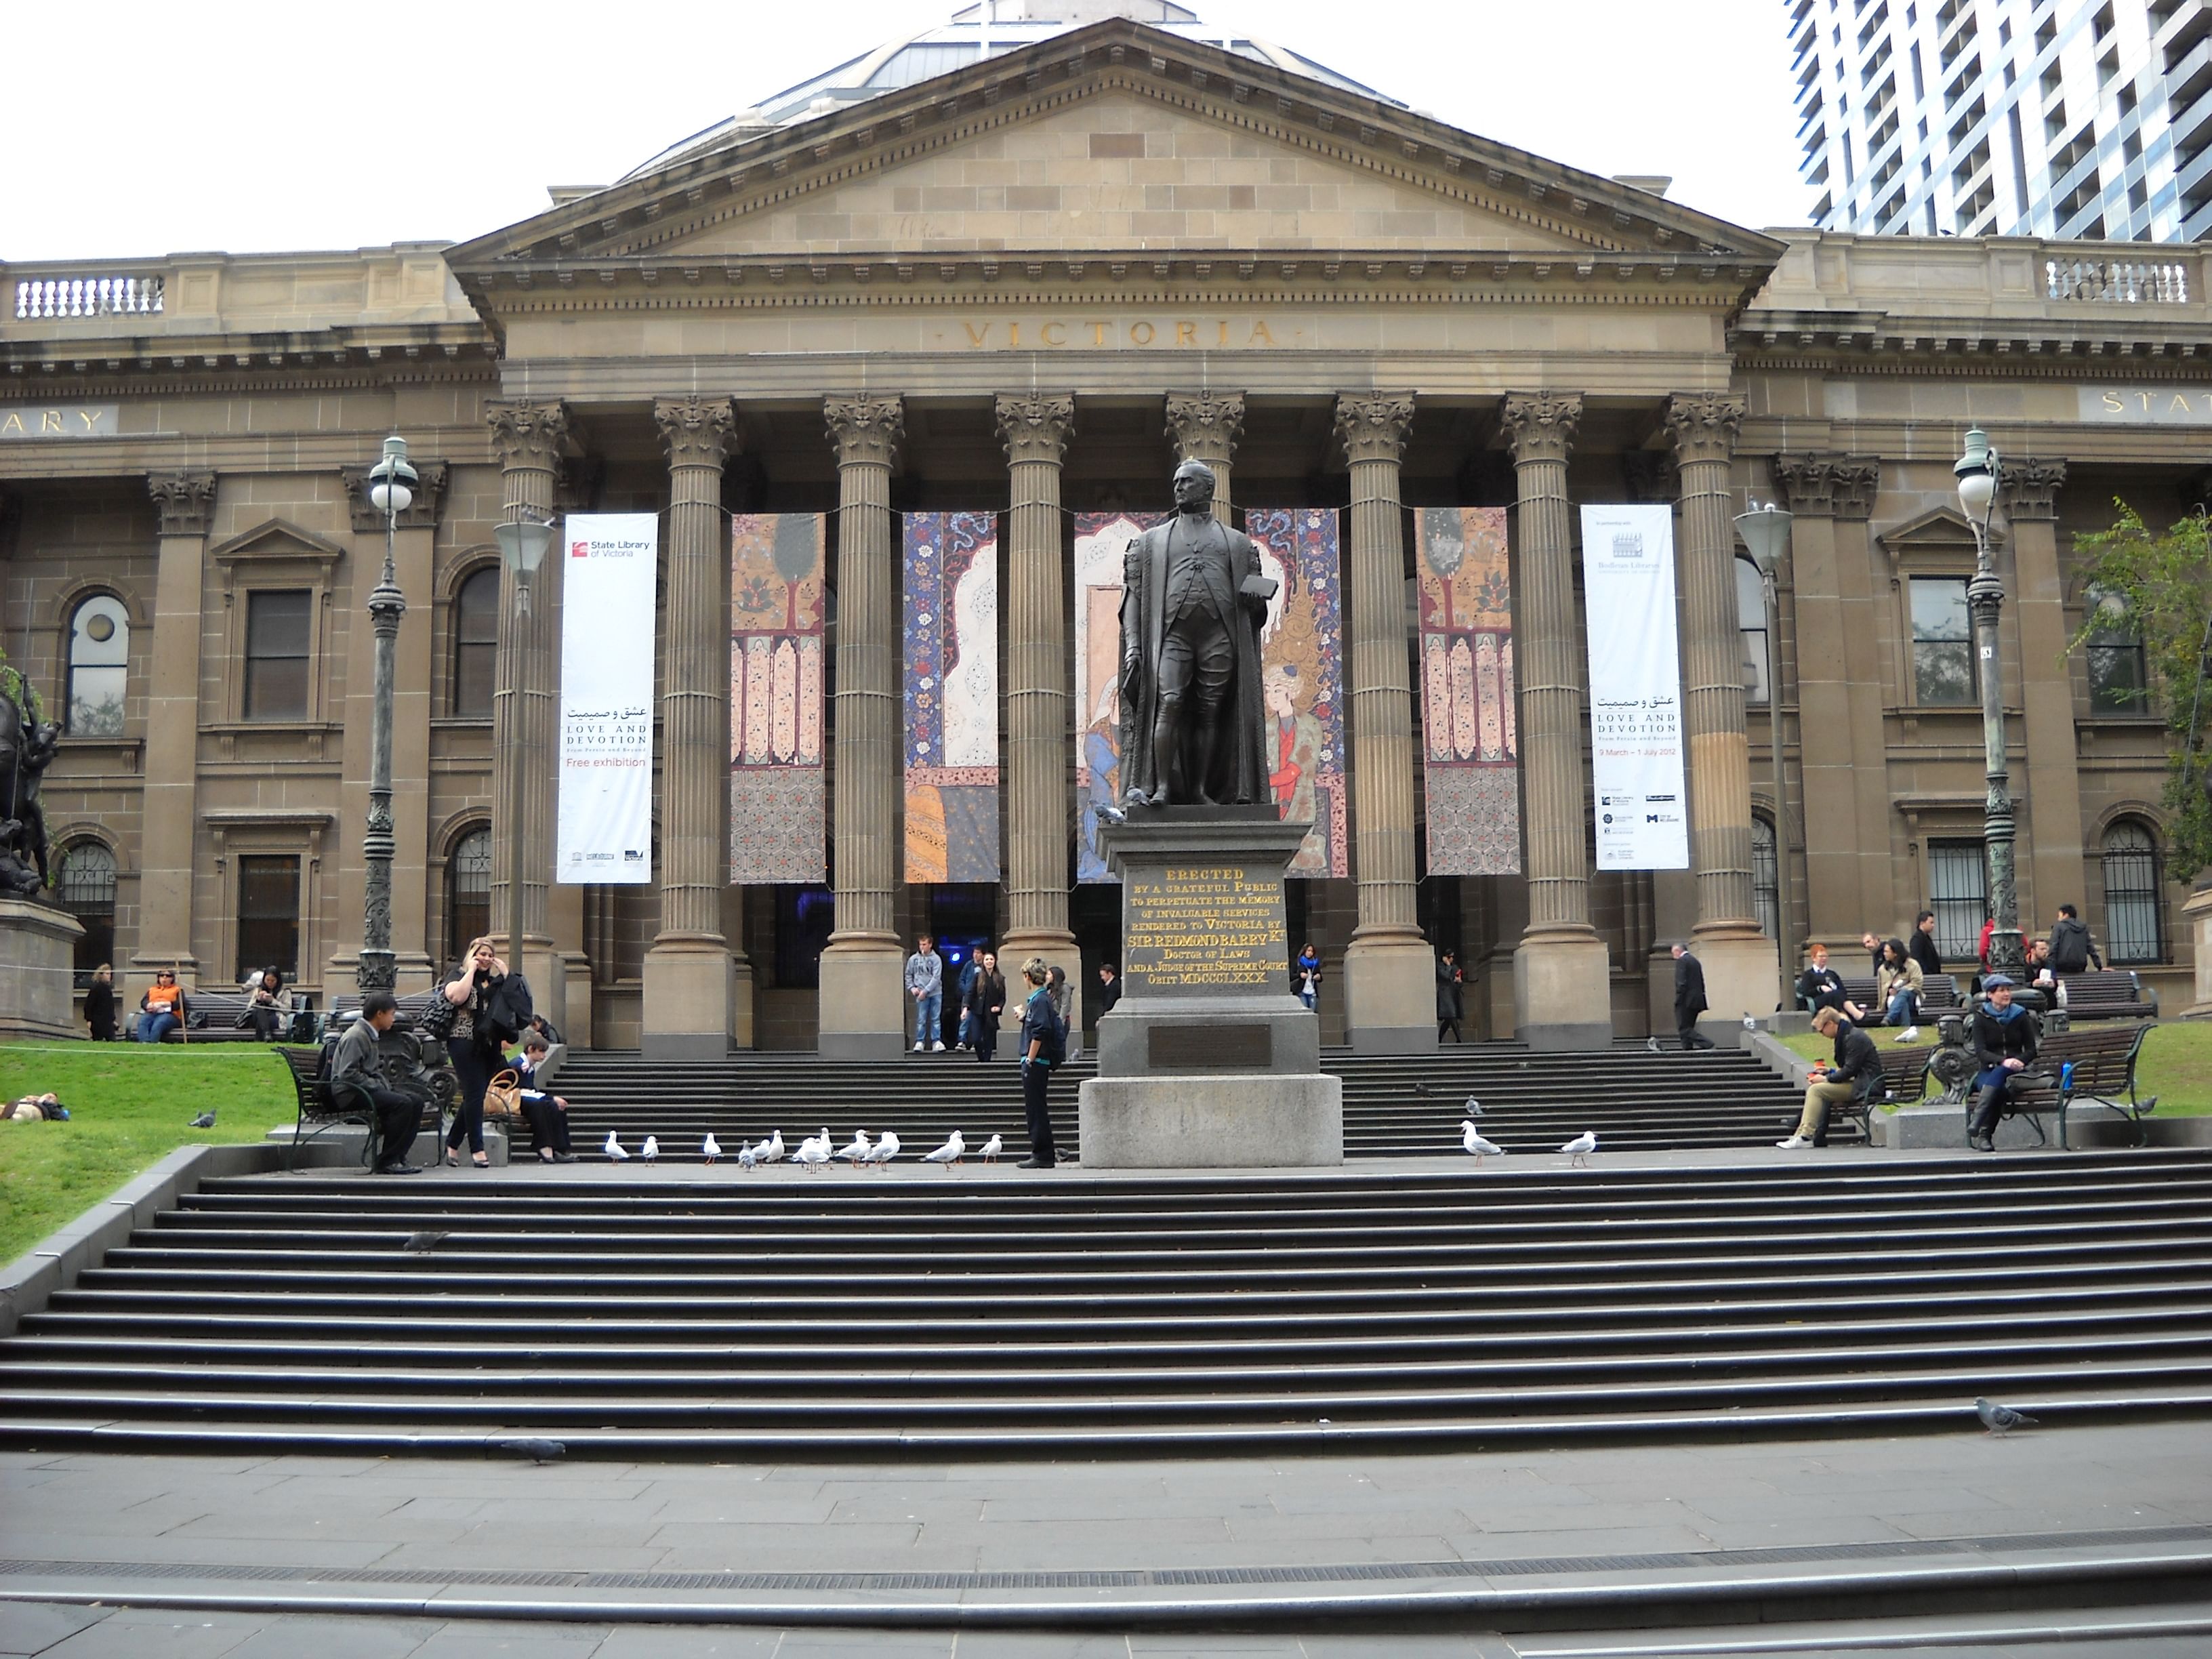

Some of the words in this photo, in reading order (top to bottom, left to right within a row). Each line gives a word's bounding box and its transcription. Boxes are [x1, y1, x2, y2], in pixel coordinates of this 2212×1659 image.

[962, 321, 1275, 347] VICTORIA
[2, 410, 102, 432] ARY
[618, 541, 650, 550] Library
[1598, 724, 1675, 733] DEVOTION
[567, 736, 646, 744] DEVOTION
[567, 758, 590, 767] Free
[594, 758, 646, 766] exhibition
[1166, 869, 1244, 880] ERECTED
[1134, 884, 1149, 894] BY
[1152, 885, 1161, 893] A
[1166, 884, 1230, 893] GRATEFUL
[1234, 881, 1277, 893] PUBLIC
[1130, 898, 1144, 906] TO
[1146, 897, 1212, 906] PERPETUATE
[1214, 897, 1236, 905] THE
[1239, 896, 1280, 904] MEMORY
[1141, 910, 1153, 919] OF
[1156, 909, 1220, 918] INVALUABLE
[1223, 909, 1270, 917] SERVICES
[1132, 922, 1187, 931] RENDERED
[1190, 922, 1203, 930] TO
[1204, 918, 1264, 930] VICTORIA
[1268, 920, 1281, 929] BY
[1127, 935, 1153, 948] SIR
[1153, 935, 1219, 947] REDMOND
[1219, 934, 1269, 946] BARRY
[1164, 949, 1203, 960] DOCTOR
[1206, 951, 1217, 959] OF
[1220, 948, 1251, 959] LAWS
[1127, 964, 1147, 973] AND
[1185, 964, 1195, 972] OF
[1195, 963, 1214, 972] THE
[1215, 960, 1258, 971] SUPREME
[1259, 960, 1288, 970] COURT
